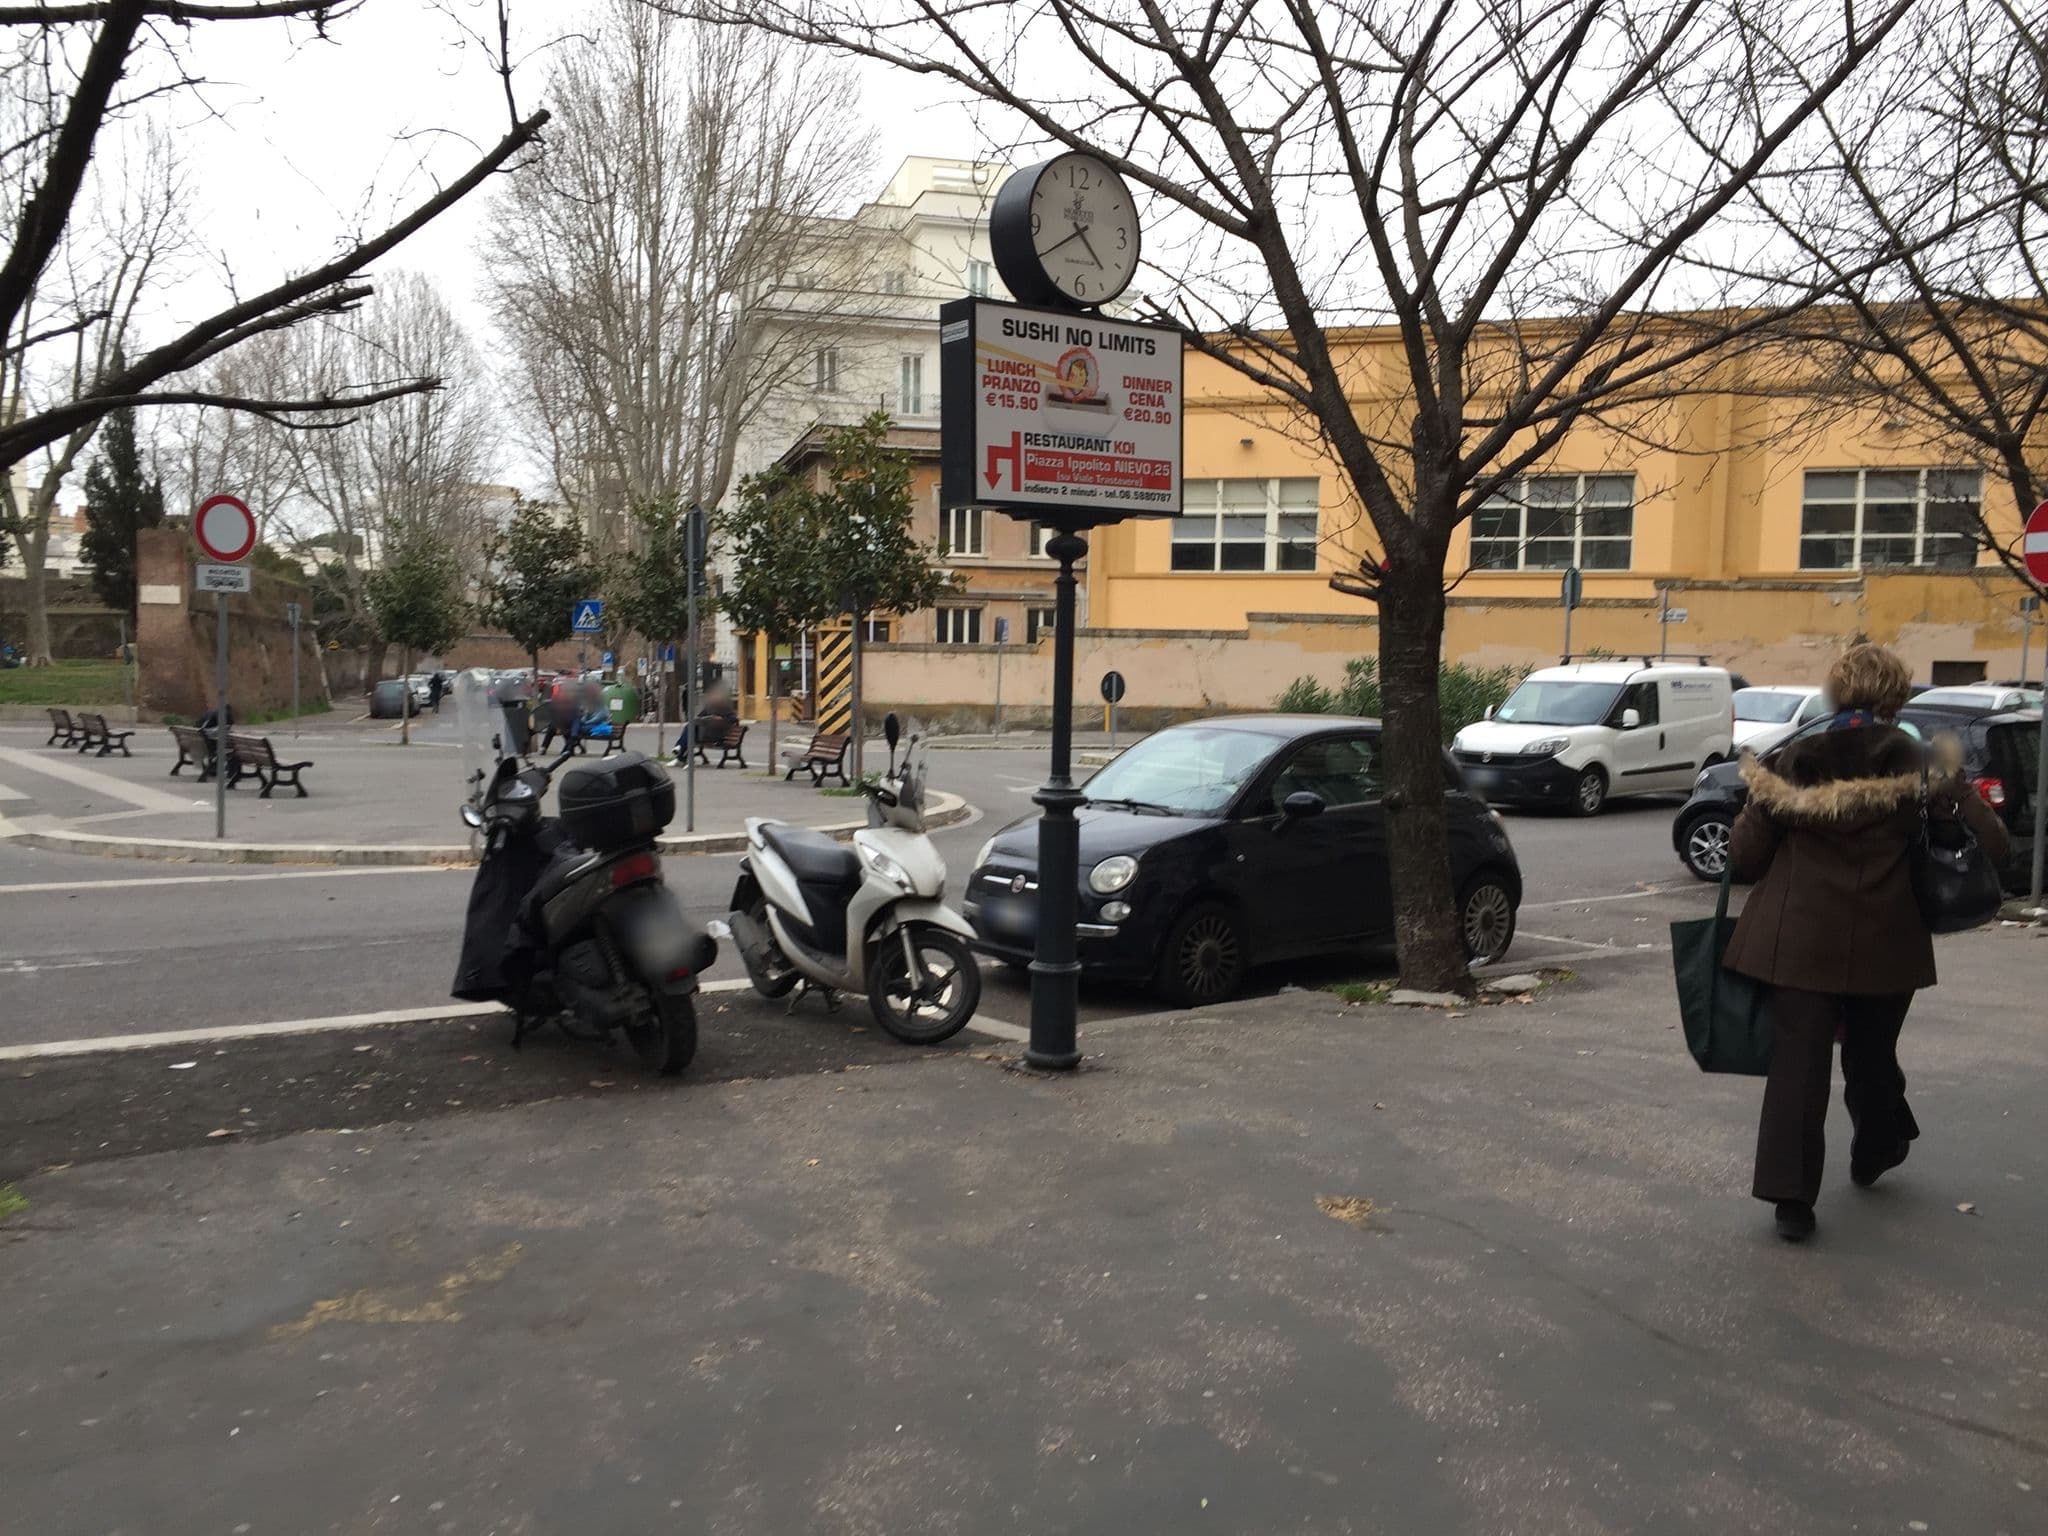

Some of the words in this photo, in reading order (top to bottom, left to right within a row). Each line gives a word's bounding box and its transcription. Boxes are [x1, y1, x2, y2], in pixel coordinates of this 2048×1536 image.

[1069, 165, 1090, 190] 12
[1030, 213, 1041, 236] 9
[1116, 227, 1127, 250] 3
[1074, 274, 1086, 296] 6
[1002, 318, 1059, 343] SUSHI
[1066, 327, 1093, 347] NO
[1099, 332, 1156, 355] LIMITS
[987, 359, 1036, 377] LUNCH
[982, 375, 1041, 394] PRANZO
[1123, 376, 1172, 393] DINNER
[1129, 392, 1165, 408] CENA
[1123, 407, 1171, 424] €20.90
[1024, 432, 1112, 453] RESTAURANT
[1114, 440, 1136, 455] KOI
[1026, 453, 1064, 468] Piazza
[1068, 457, 1111, 472] Ippolito
[1073, 471, 1094, 483] Viale
[1024, 483, 1059, 495] indietro
[1061, 486, 1068, 495] 2
[1070, 487, 1097, 497] minuti
